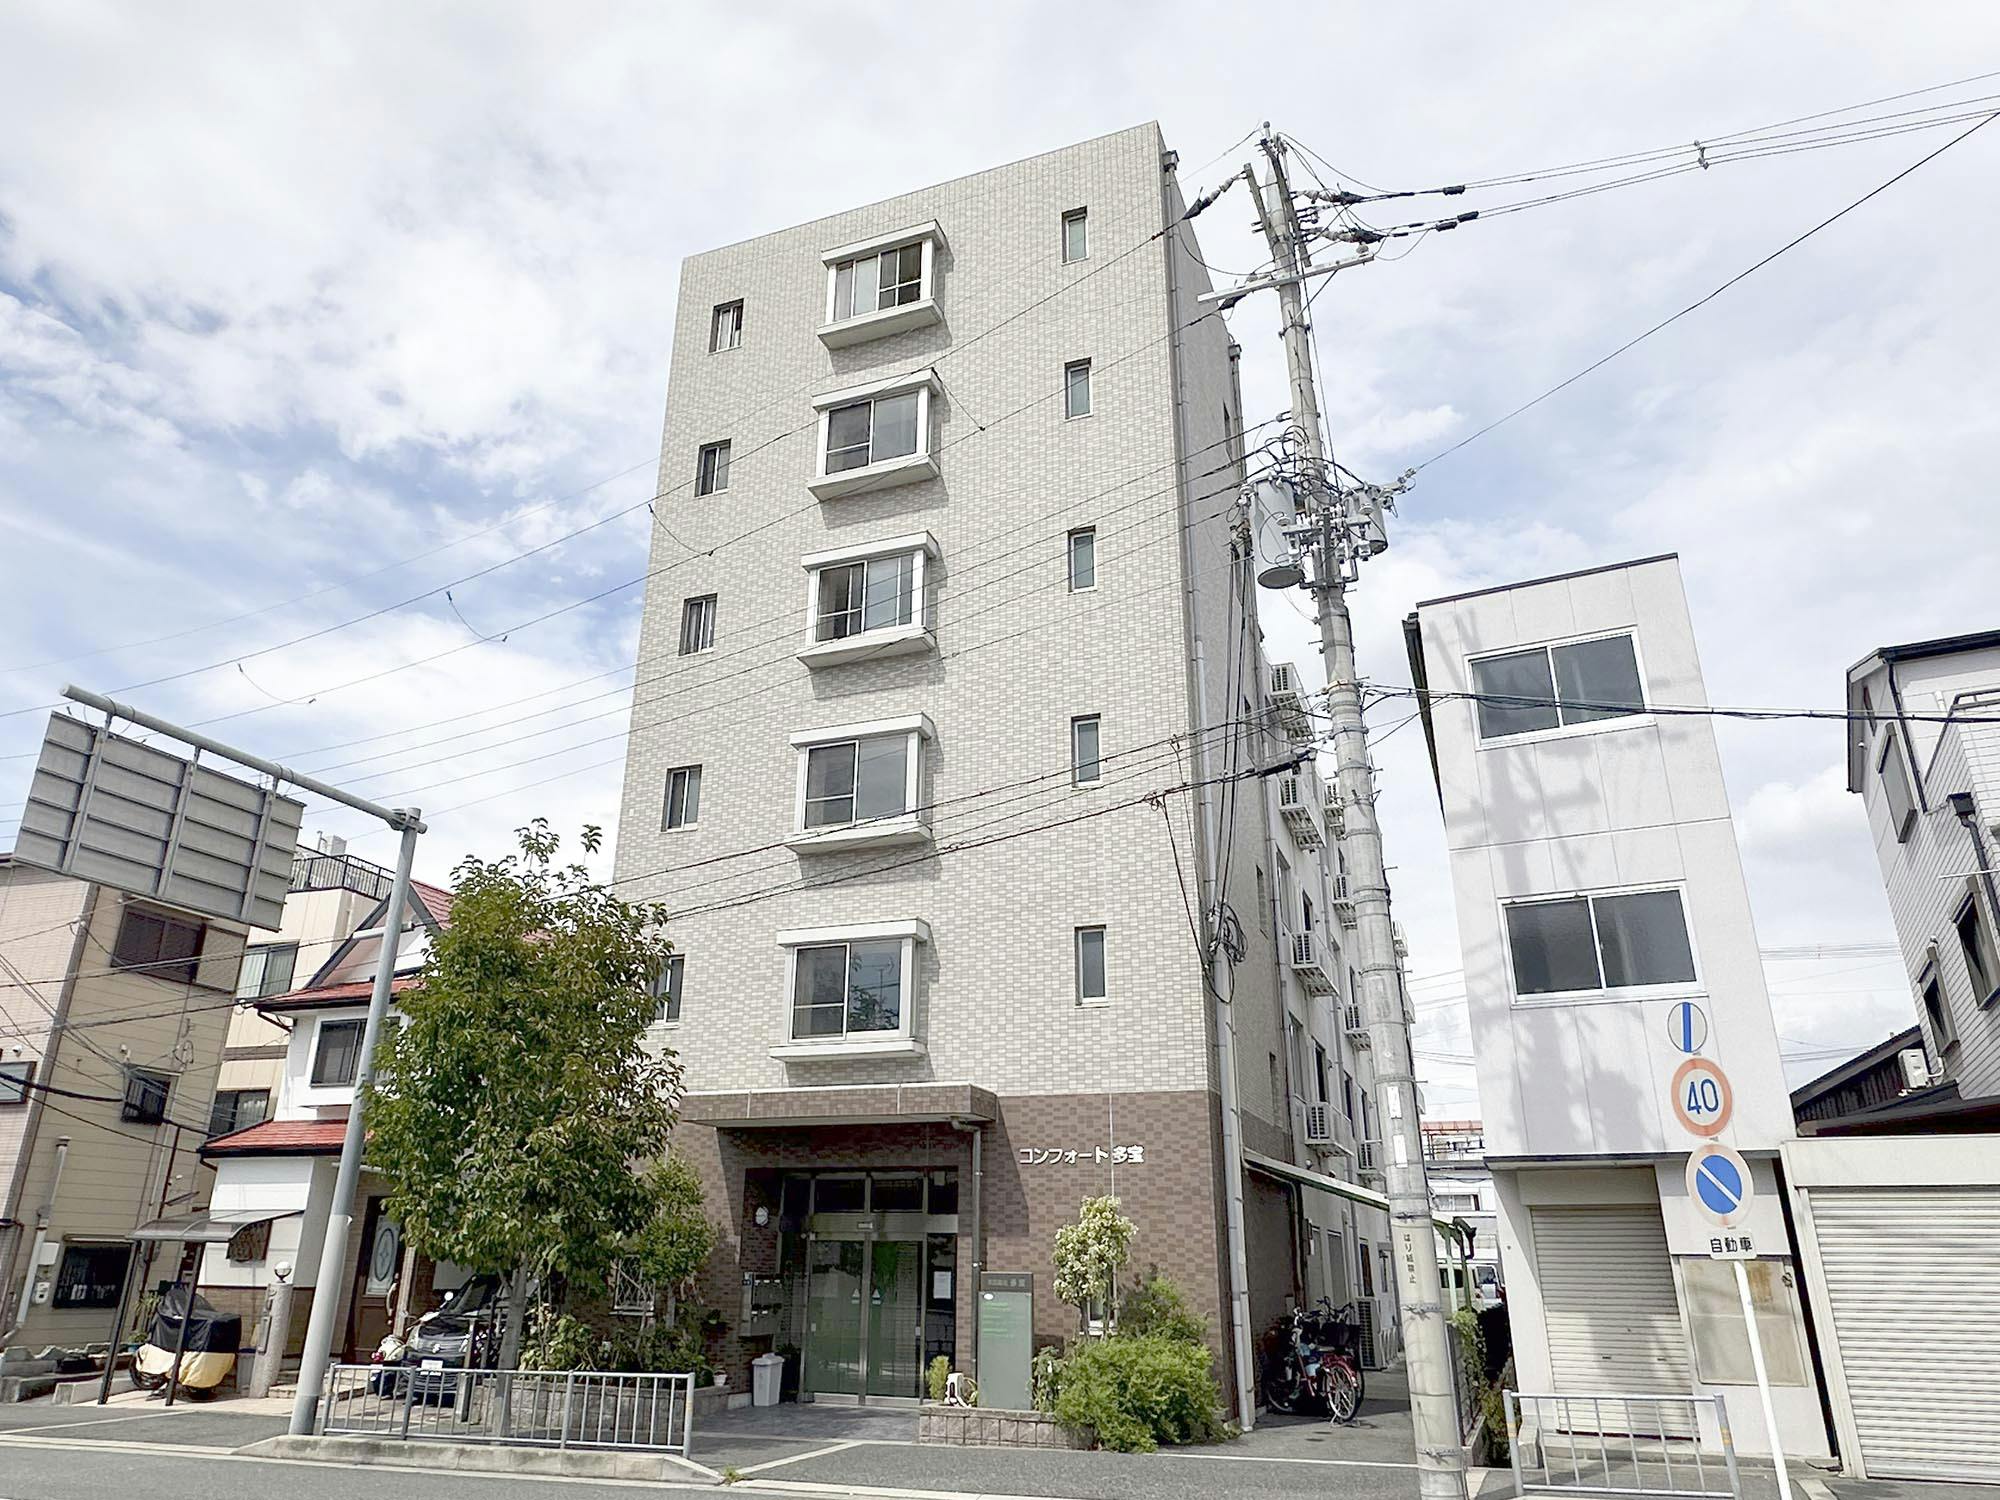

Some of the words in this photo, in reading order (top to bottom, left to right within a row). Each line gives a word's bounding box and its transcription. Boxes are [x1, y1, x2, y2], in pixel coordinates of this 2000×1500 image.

[1687, 1078, 1719, 1114] 40
[1710, 1236, 1753, 1253] 自動車
